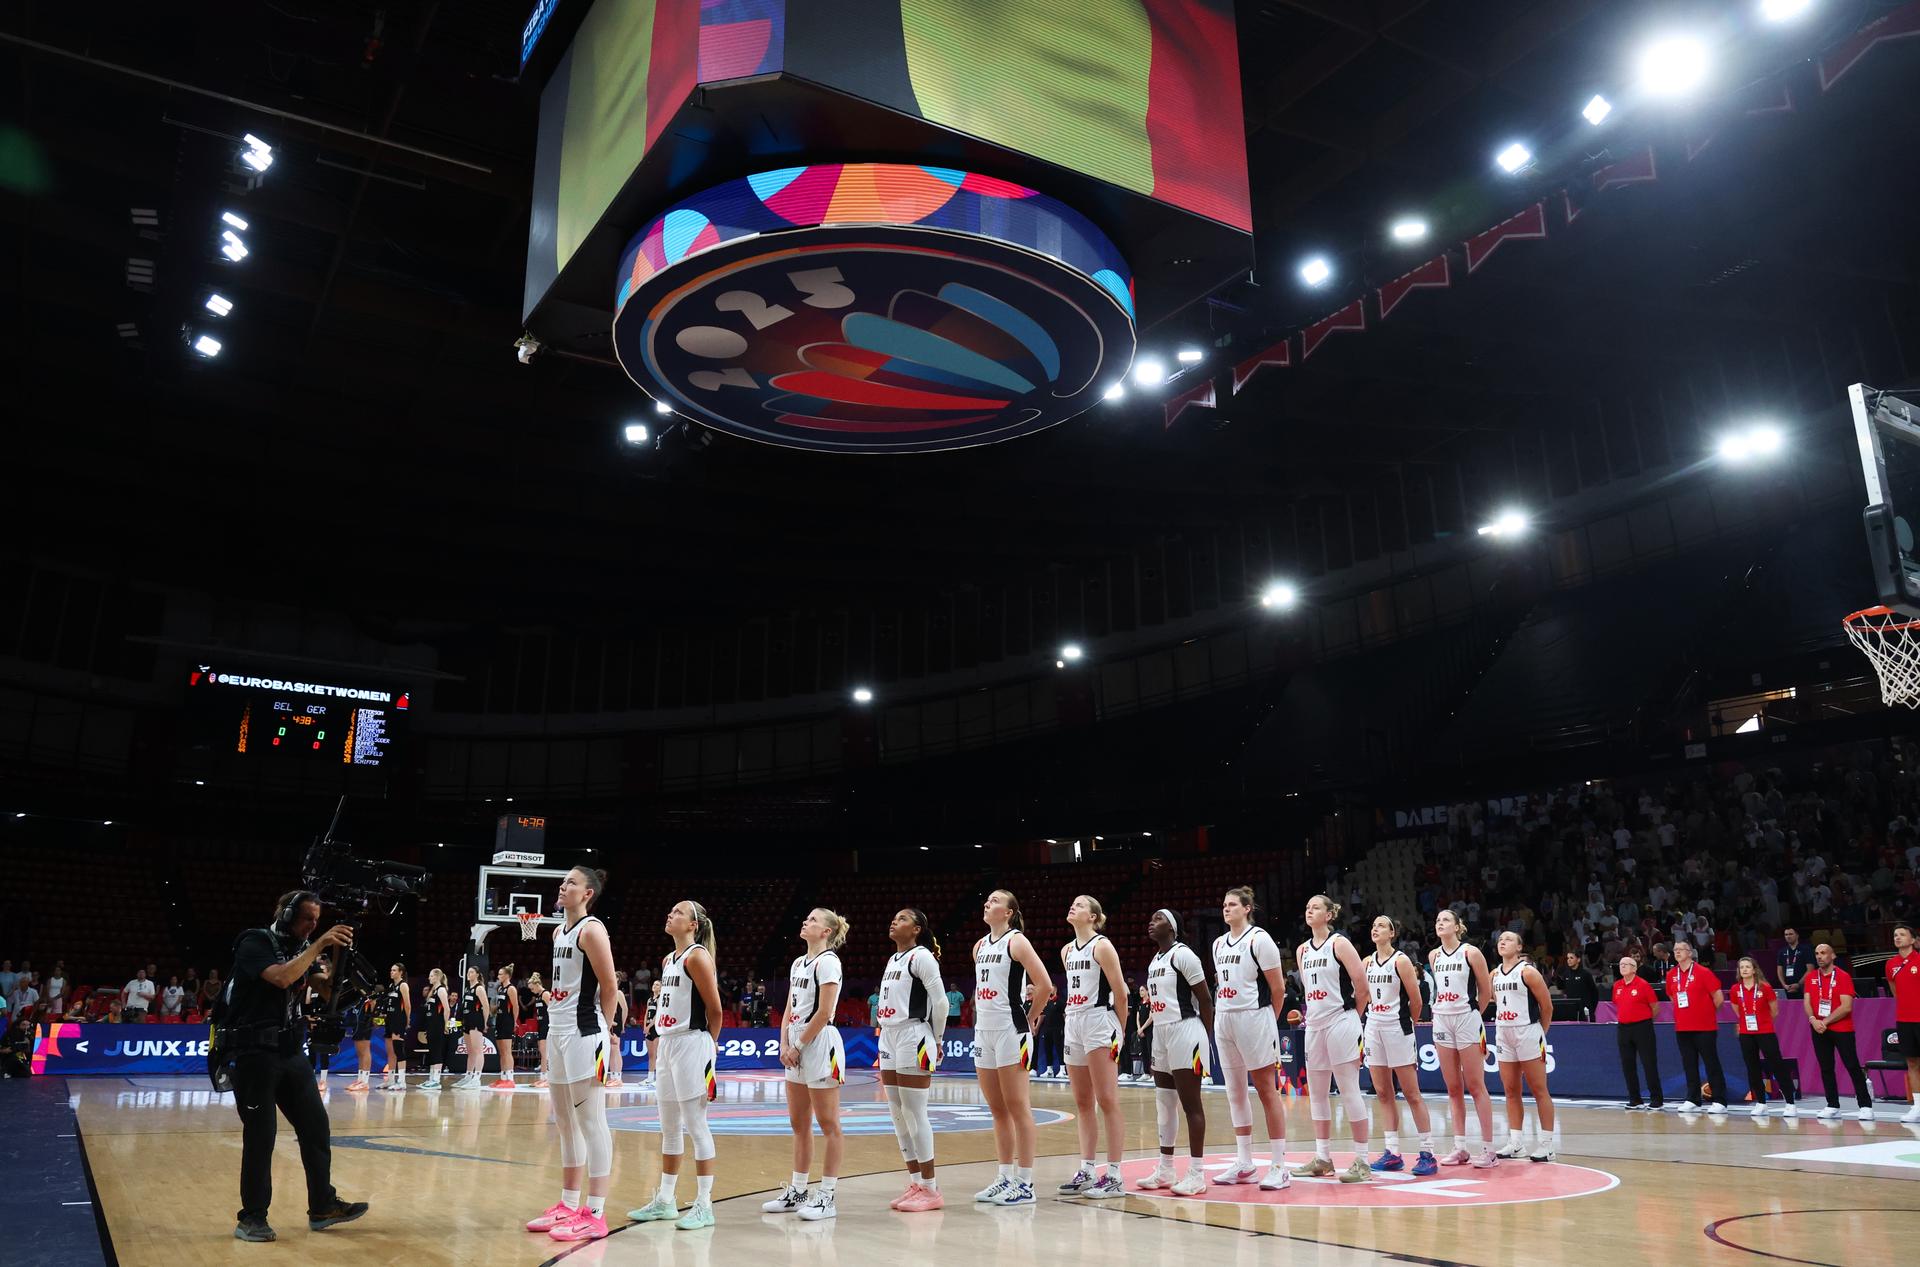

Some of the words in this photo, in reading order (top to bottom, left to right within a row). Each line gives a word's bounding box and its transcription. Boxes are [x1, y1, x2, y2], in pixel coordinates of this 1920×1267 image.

[676, 266, 856, 392] 2025
[218, 673, 391, 702] @EUROBASKETWOMEN
[274, 701, 293, 712] BEL
[307, 704, 327, 714] GER
[279, 727, 286, 736] 0
[318, 731, 325, 740] 0
[273, 737, 280, 746] 0
[313, 741, 320, 750] 0
[1395, 805, 1448, 828] DARE
[516, 854, 543, 862] TISSOT
[1311, 973, 1317, 985] 11
[1444, 976, 1449, 987] 5
[662, 993, 670, 1008] 55
